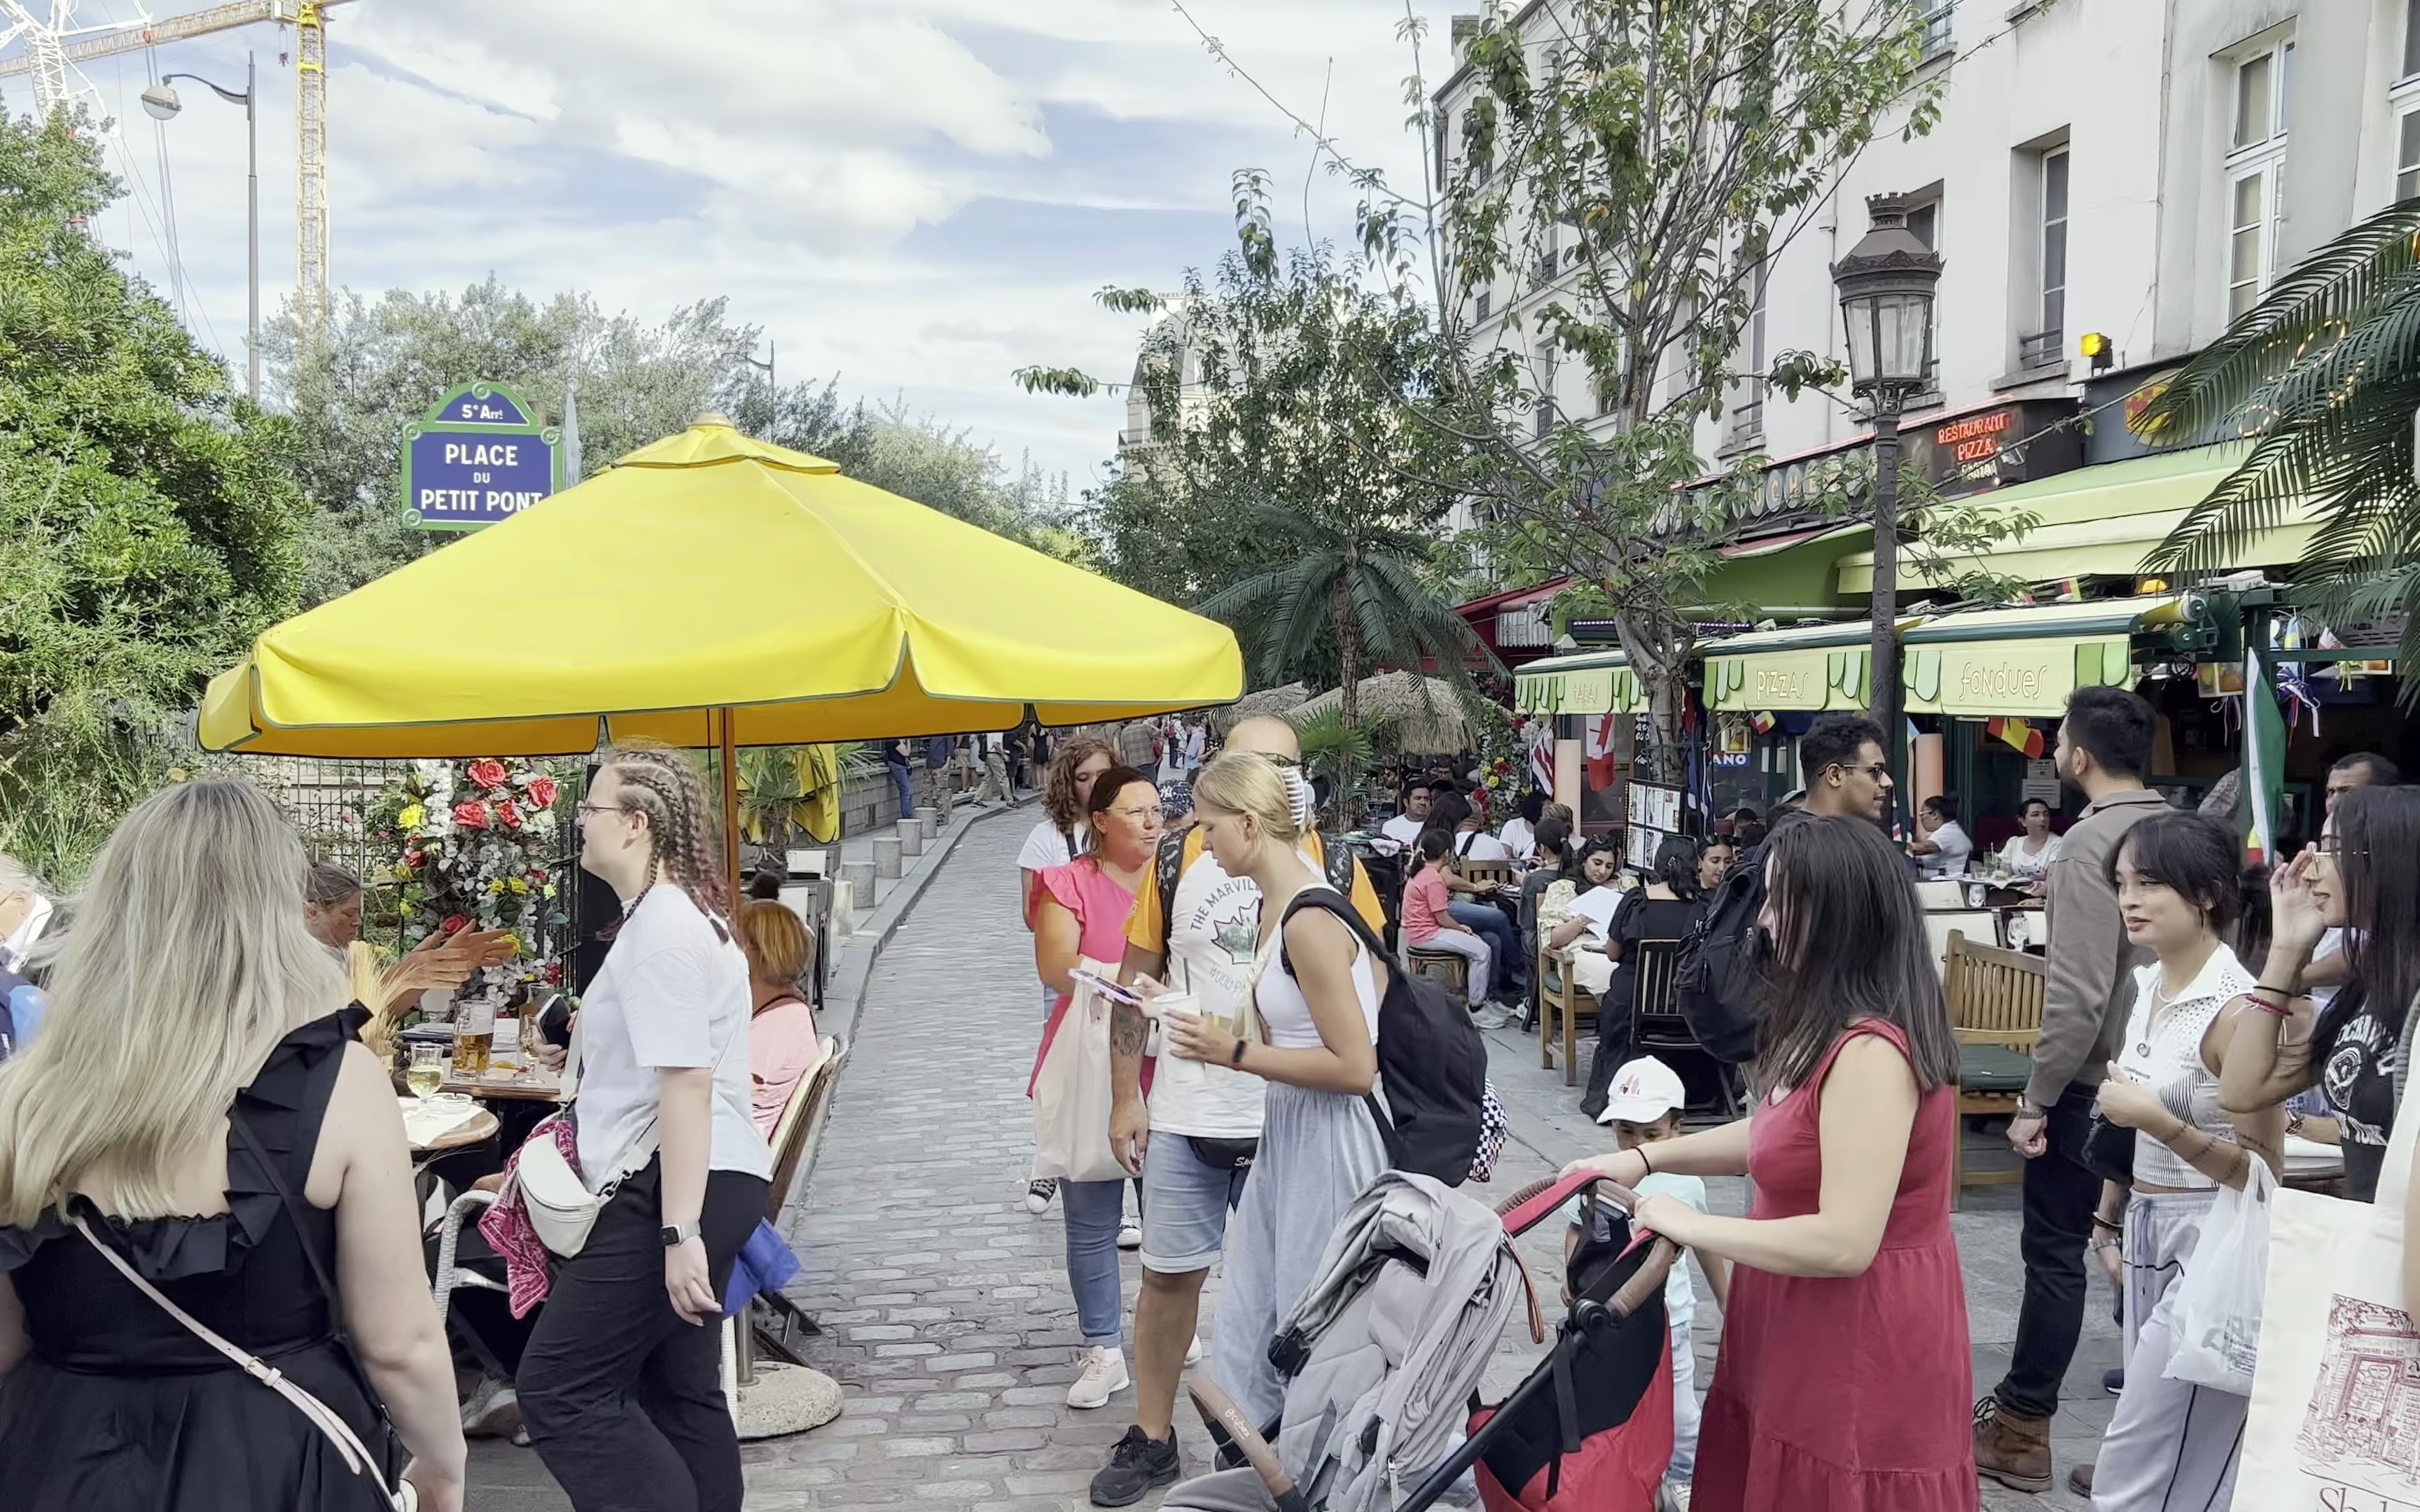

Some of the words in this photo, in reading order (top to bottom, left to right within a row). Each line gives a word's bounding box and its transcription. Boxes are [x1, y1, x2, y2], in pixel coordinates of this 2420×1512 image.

[445, 443, 519, 467] PLACE
[1957, 438, 1996, 461] PIZZA
[473, 472, 490, 484] DU
[420, 489, 479, 511] PETIT
[486, 491, 543, 512] PONT
[1190, 906, 1210, 930] THE
[1231, 1415, 1251, 1438] cybex
